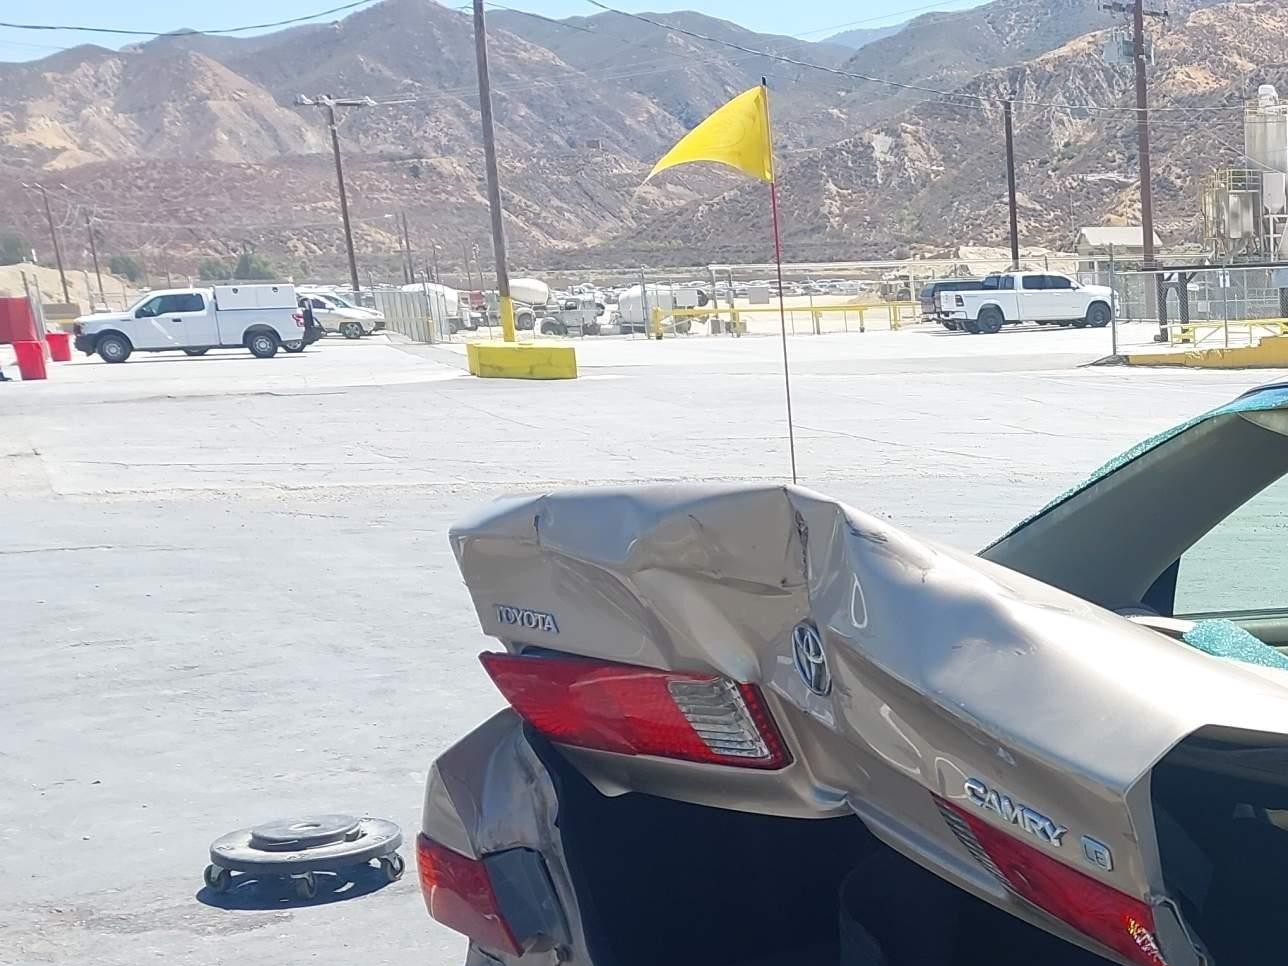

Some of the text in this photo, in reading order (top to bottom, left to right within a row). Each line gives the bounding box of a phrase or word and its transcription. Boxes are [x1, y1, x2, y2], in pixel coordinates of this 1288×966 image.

[495, 604, 560, 633] TOYOTA
[964, 777, 1069, 847] CAMRY
[1083, 841, 1109, 868] LE
